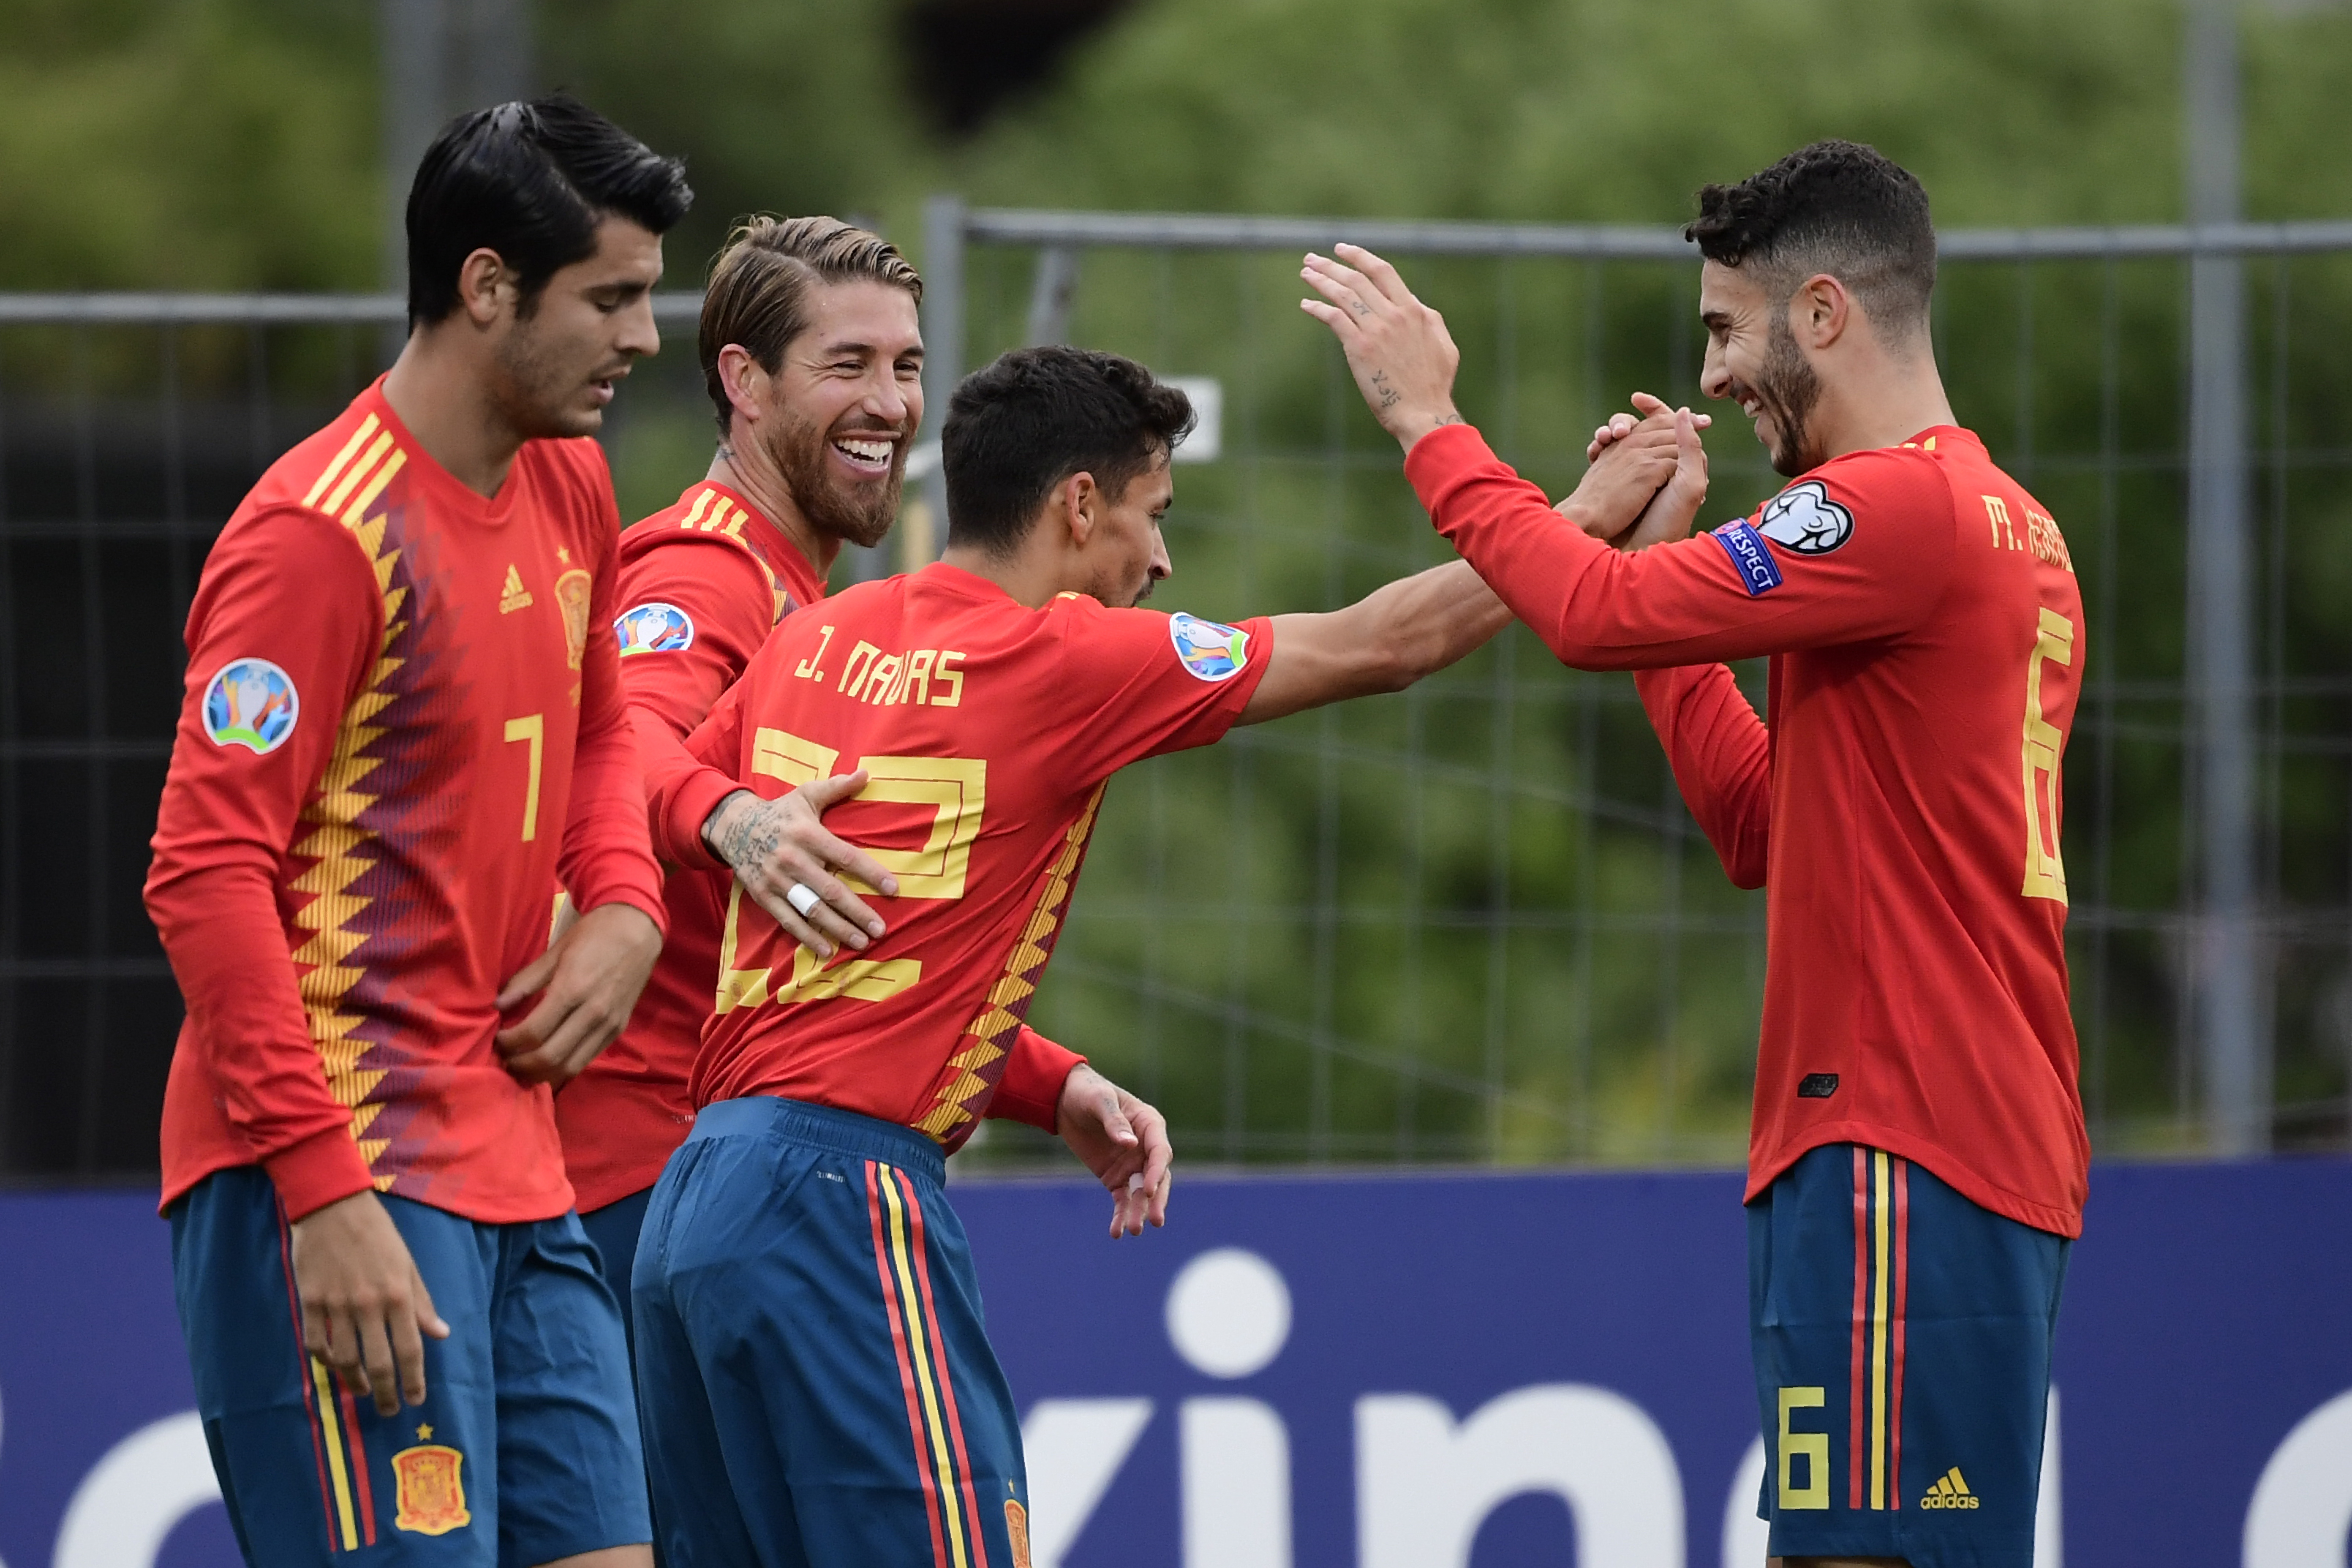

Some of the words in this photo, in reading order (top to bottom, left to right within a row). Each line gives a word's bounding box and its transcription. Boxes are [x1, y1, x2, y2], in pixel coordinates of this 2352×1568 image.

[1727, 528, 1774, 588] RESPECT
[794, 625, 836, 683] J.
[504, 713, 544, 842] 7
[2020, 606, 2074, 908] 6
[1778, 1386, 1829, 1510] 6
[1920, 1492, 1980, 1510] adidas
